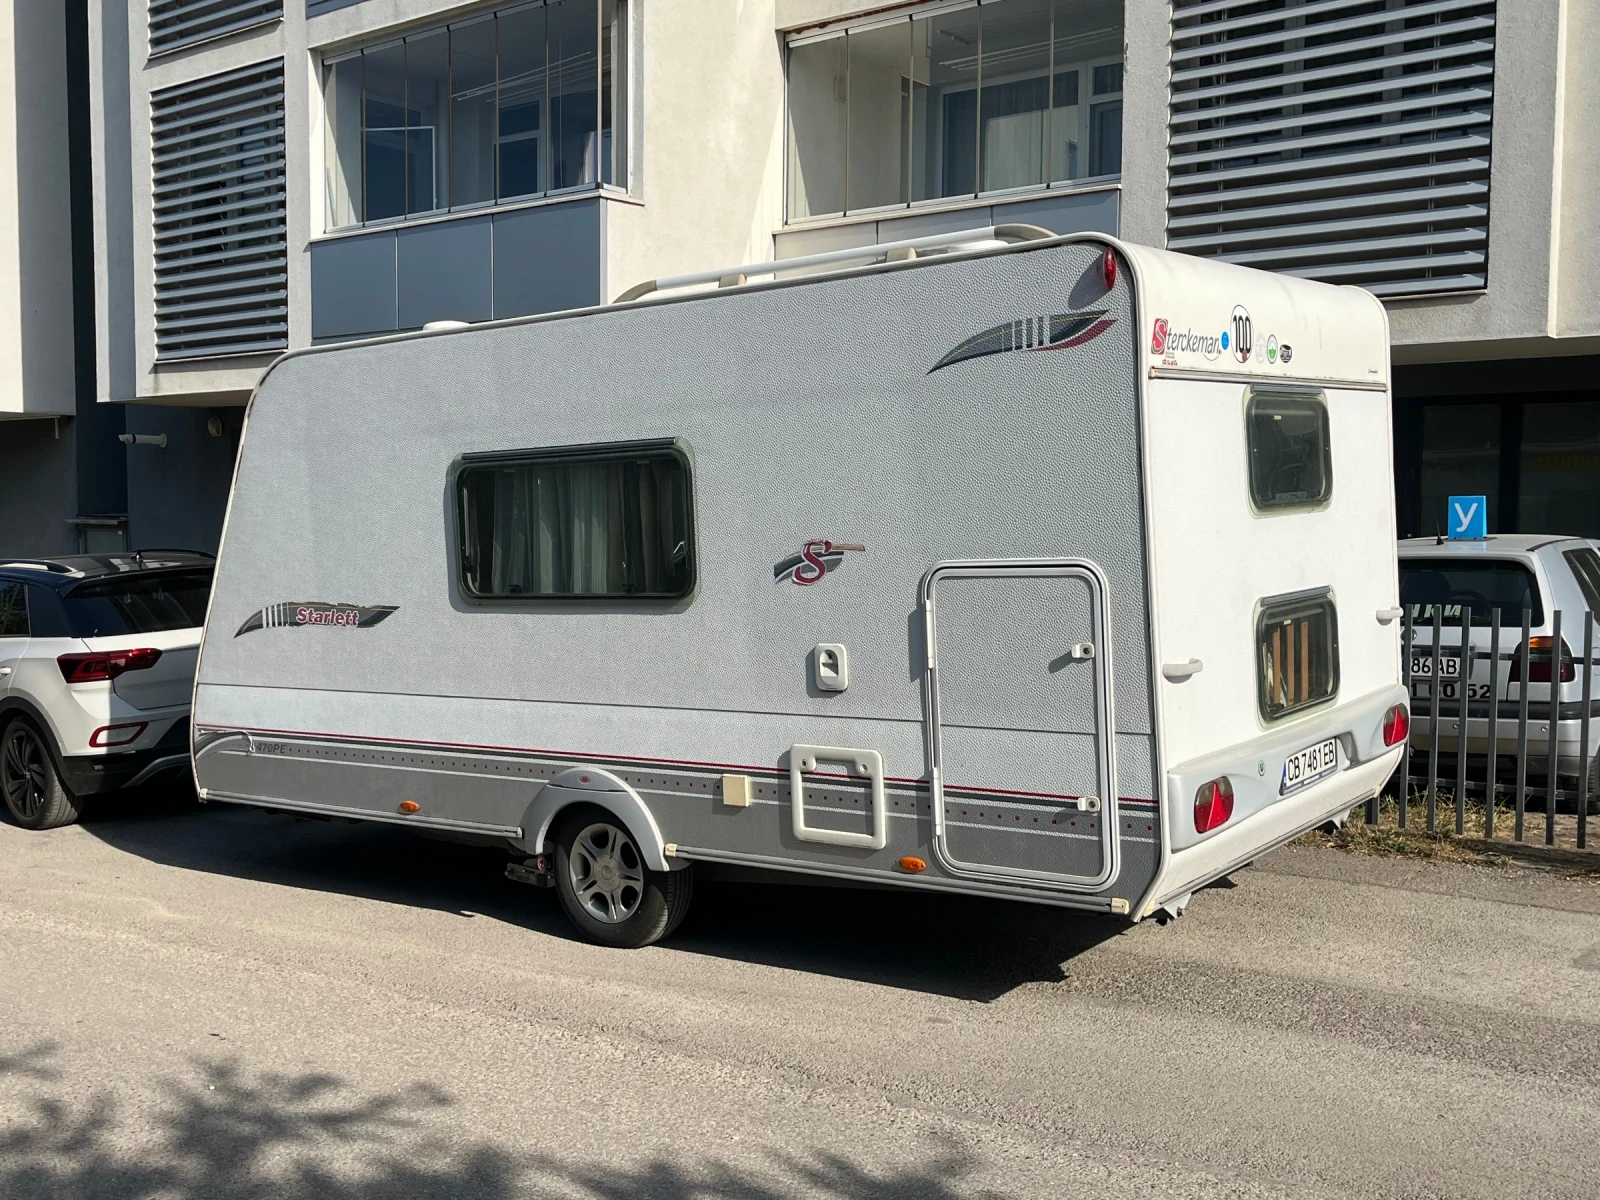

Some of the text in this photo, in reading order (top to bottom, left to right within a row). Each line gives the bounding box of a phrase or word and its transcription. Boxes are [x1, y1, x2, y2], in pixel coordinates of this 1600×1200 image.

[1151, 318, 1220, 356] Sterckeman
[1233, 314, 1252, 354] 100
[296, 607, 359, 626] Starlett
[256, 743, 286, 754] 470PE
